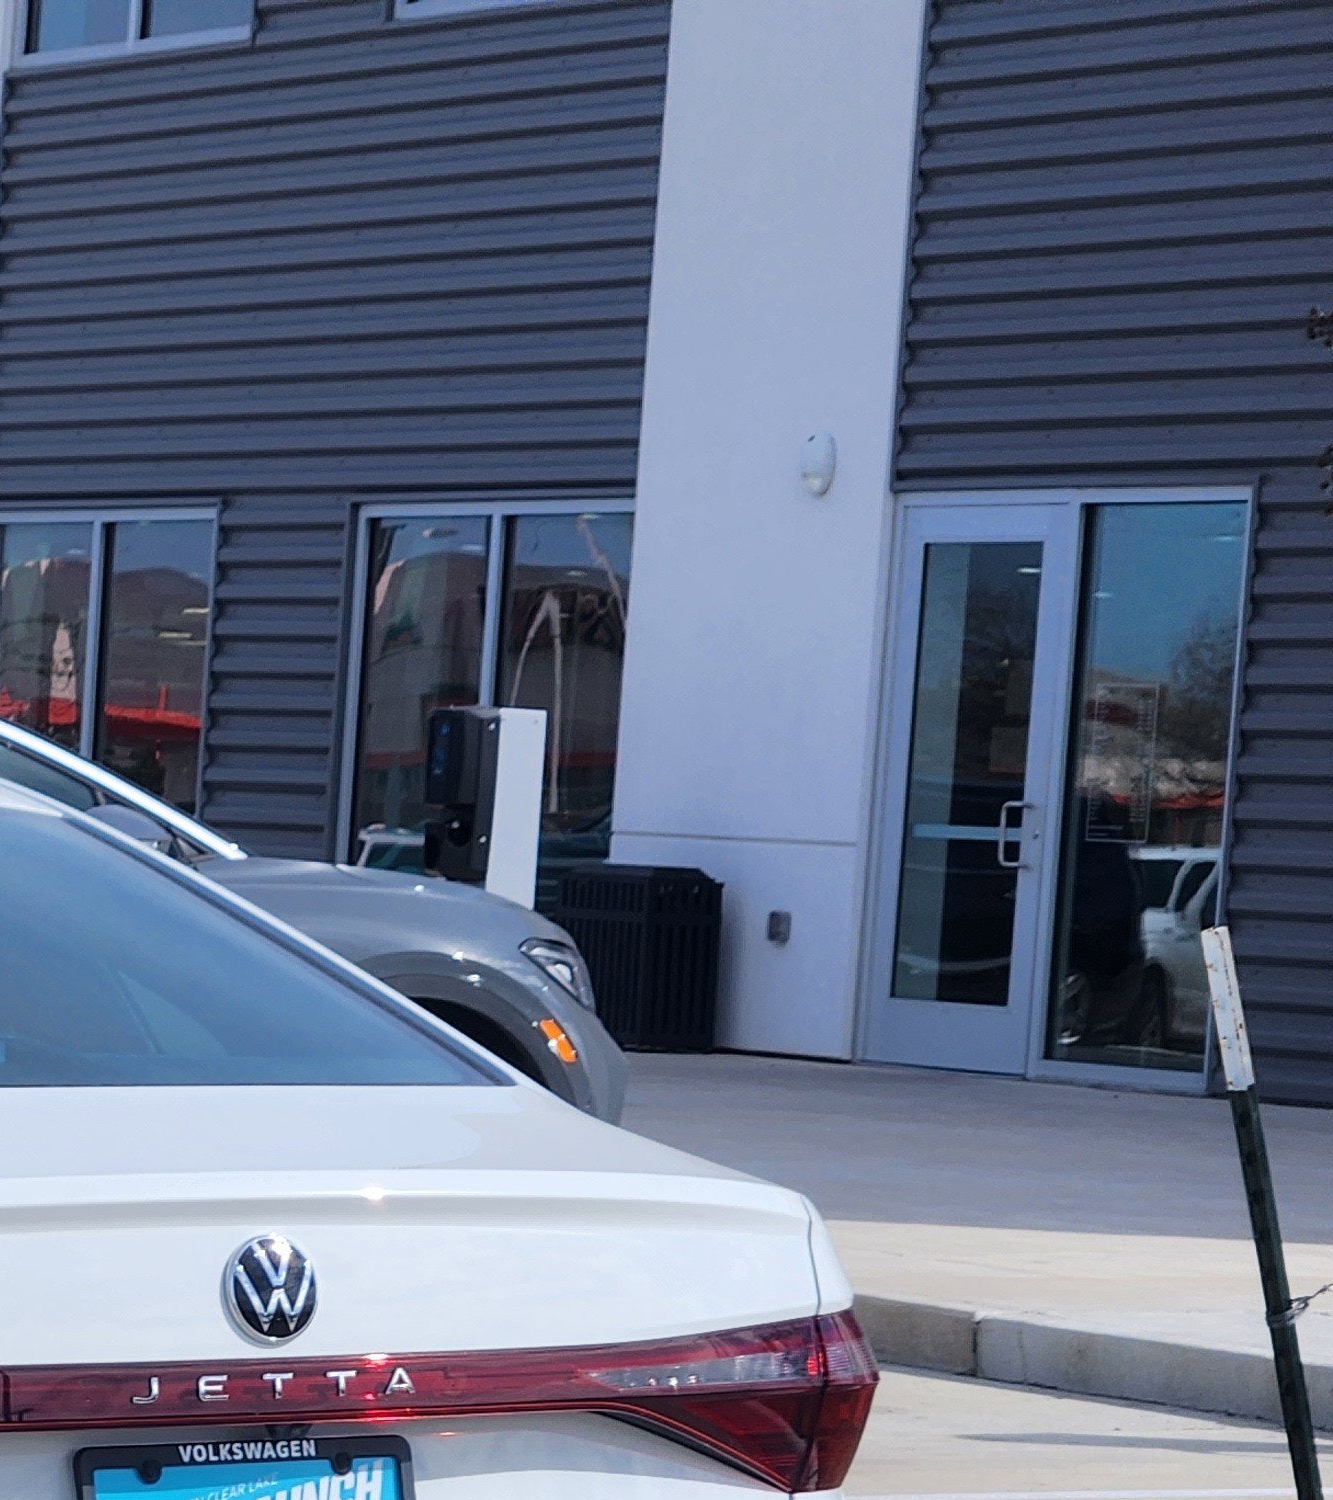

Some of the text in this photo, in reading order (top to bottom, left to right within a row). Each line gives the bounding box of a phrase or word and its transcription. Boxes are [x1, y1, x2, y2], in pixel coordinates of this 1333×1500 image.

[131, 1367, 416, 1405] JETTA
[178, 1439, 316, 1464] VOLKSWAGEN
[248, 1471, 279, 1494] LAKE
